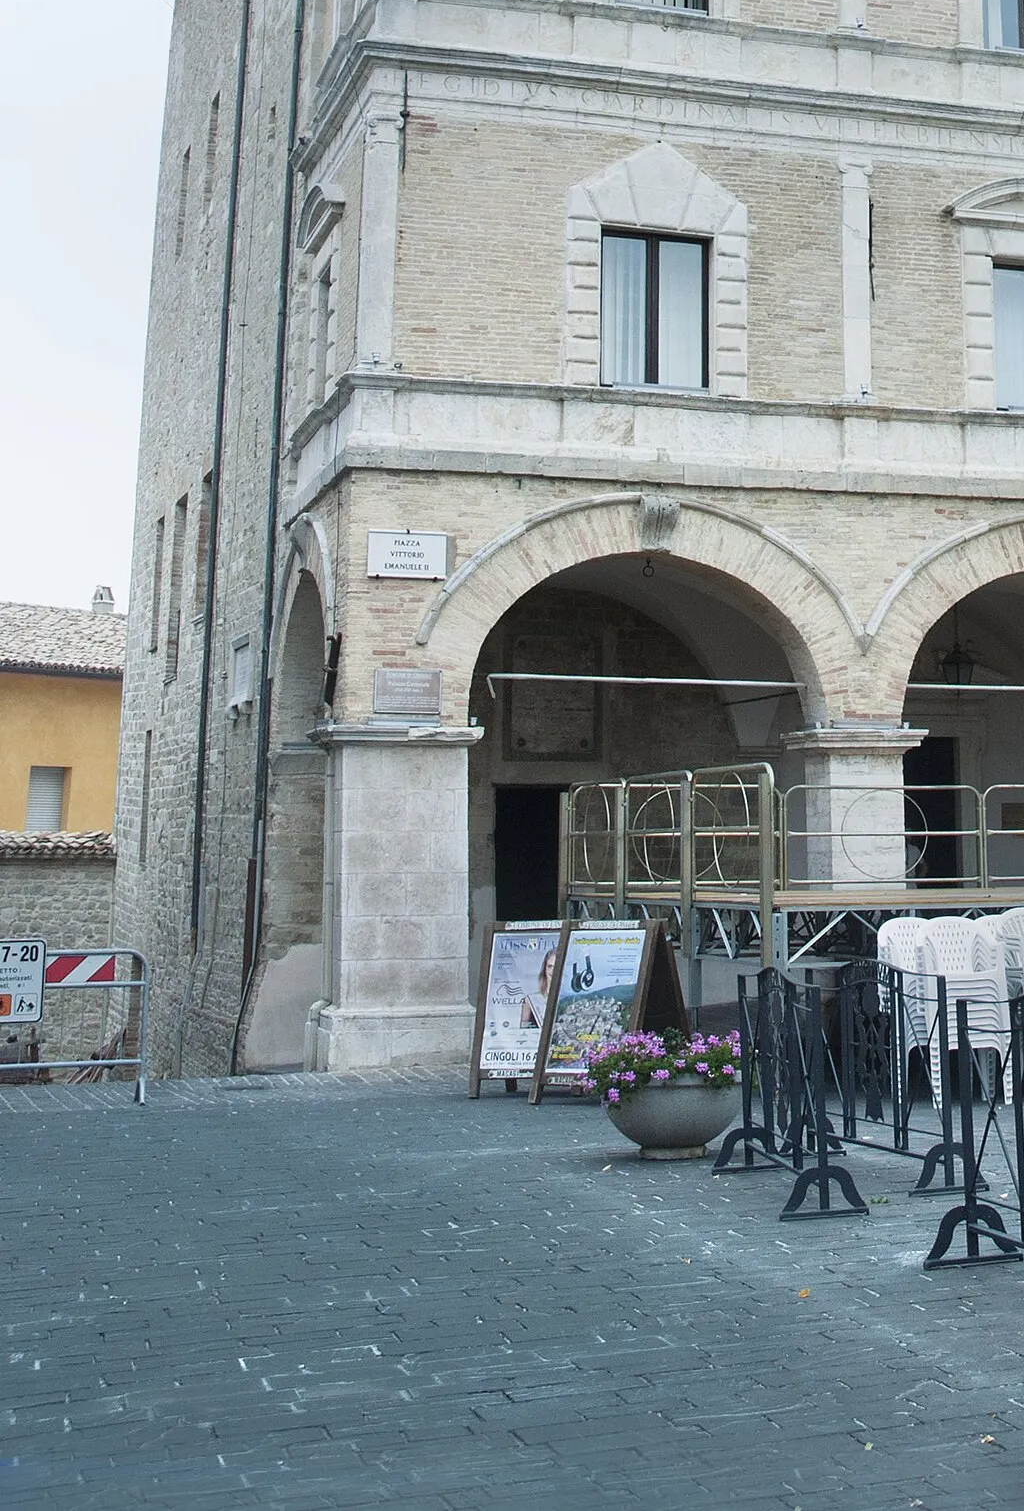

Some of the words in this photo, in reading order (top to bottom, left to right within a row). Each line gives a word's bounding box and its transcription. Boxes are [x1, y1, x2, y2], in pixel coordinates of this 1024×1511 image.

[394, 539, 421, 547] PIAZZA
[389, 550, 425, 559] VITTORIO
[384, 563, 422, 571] EMANUELE
[423, 563, 430, 571] II
[492, 997, 526, 1005] WELLA
[484, 1051, 519, 1062] CINGOLI
[522, 1052, 531, 1061] 16
